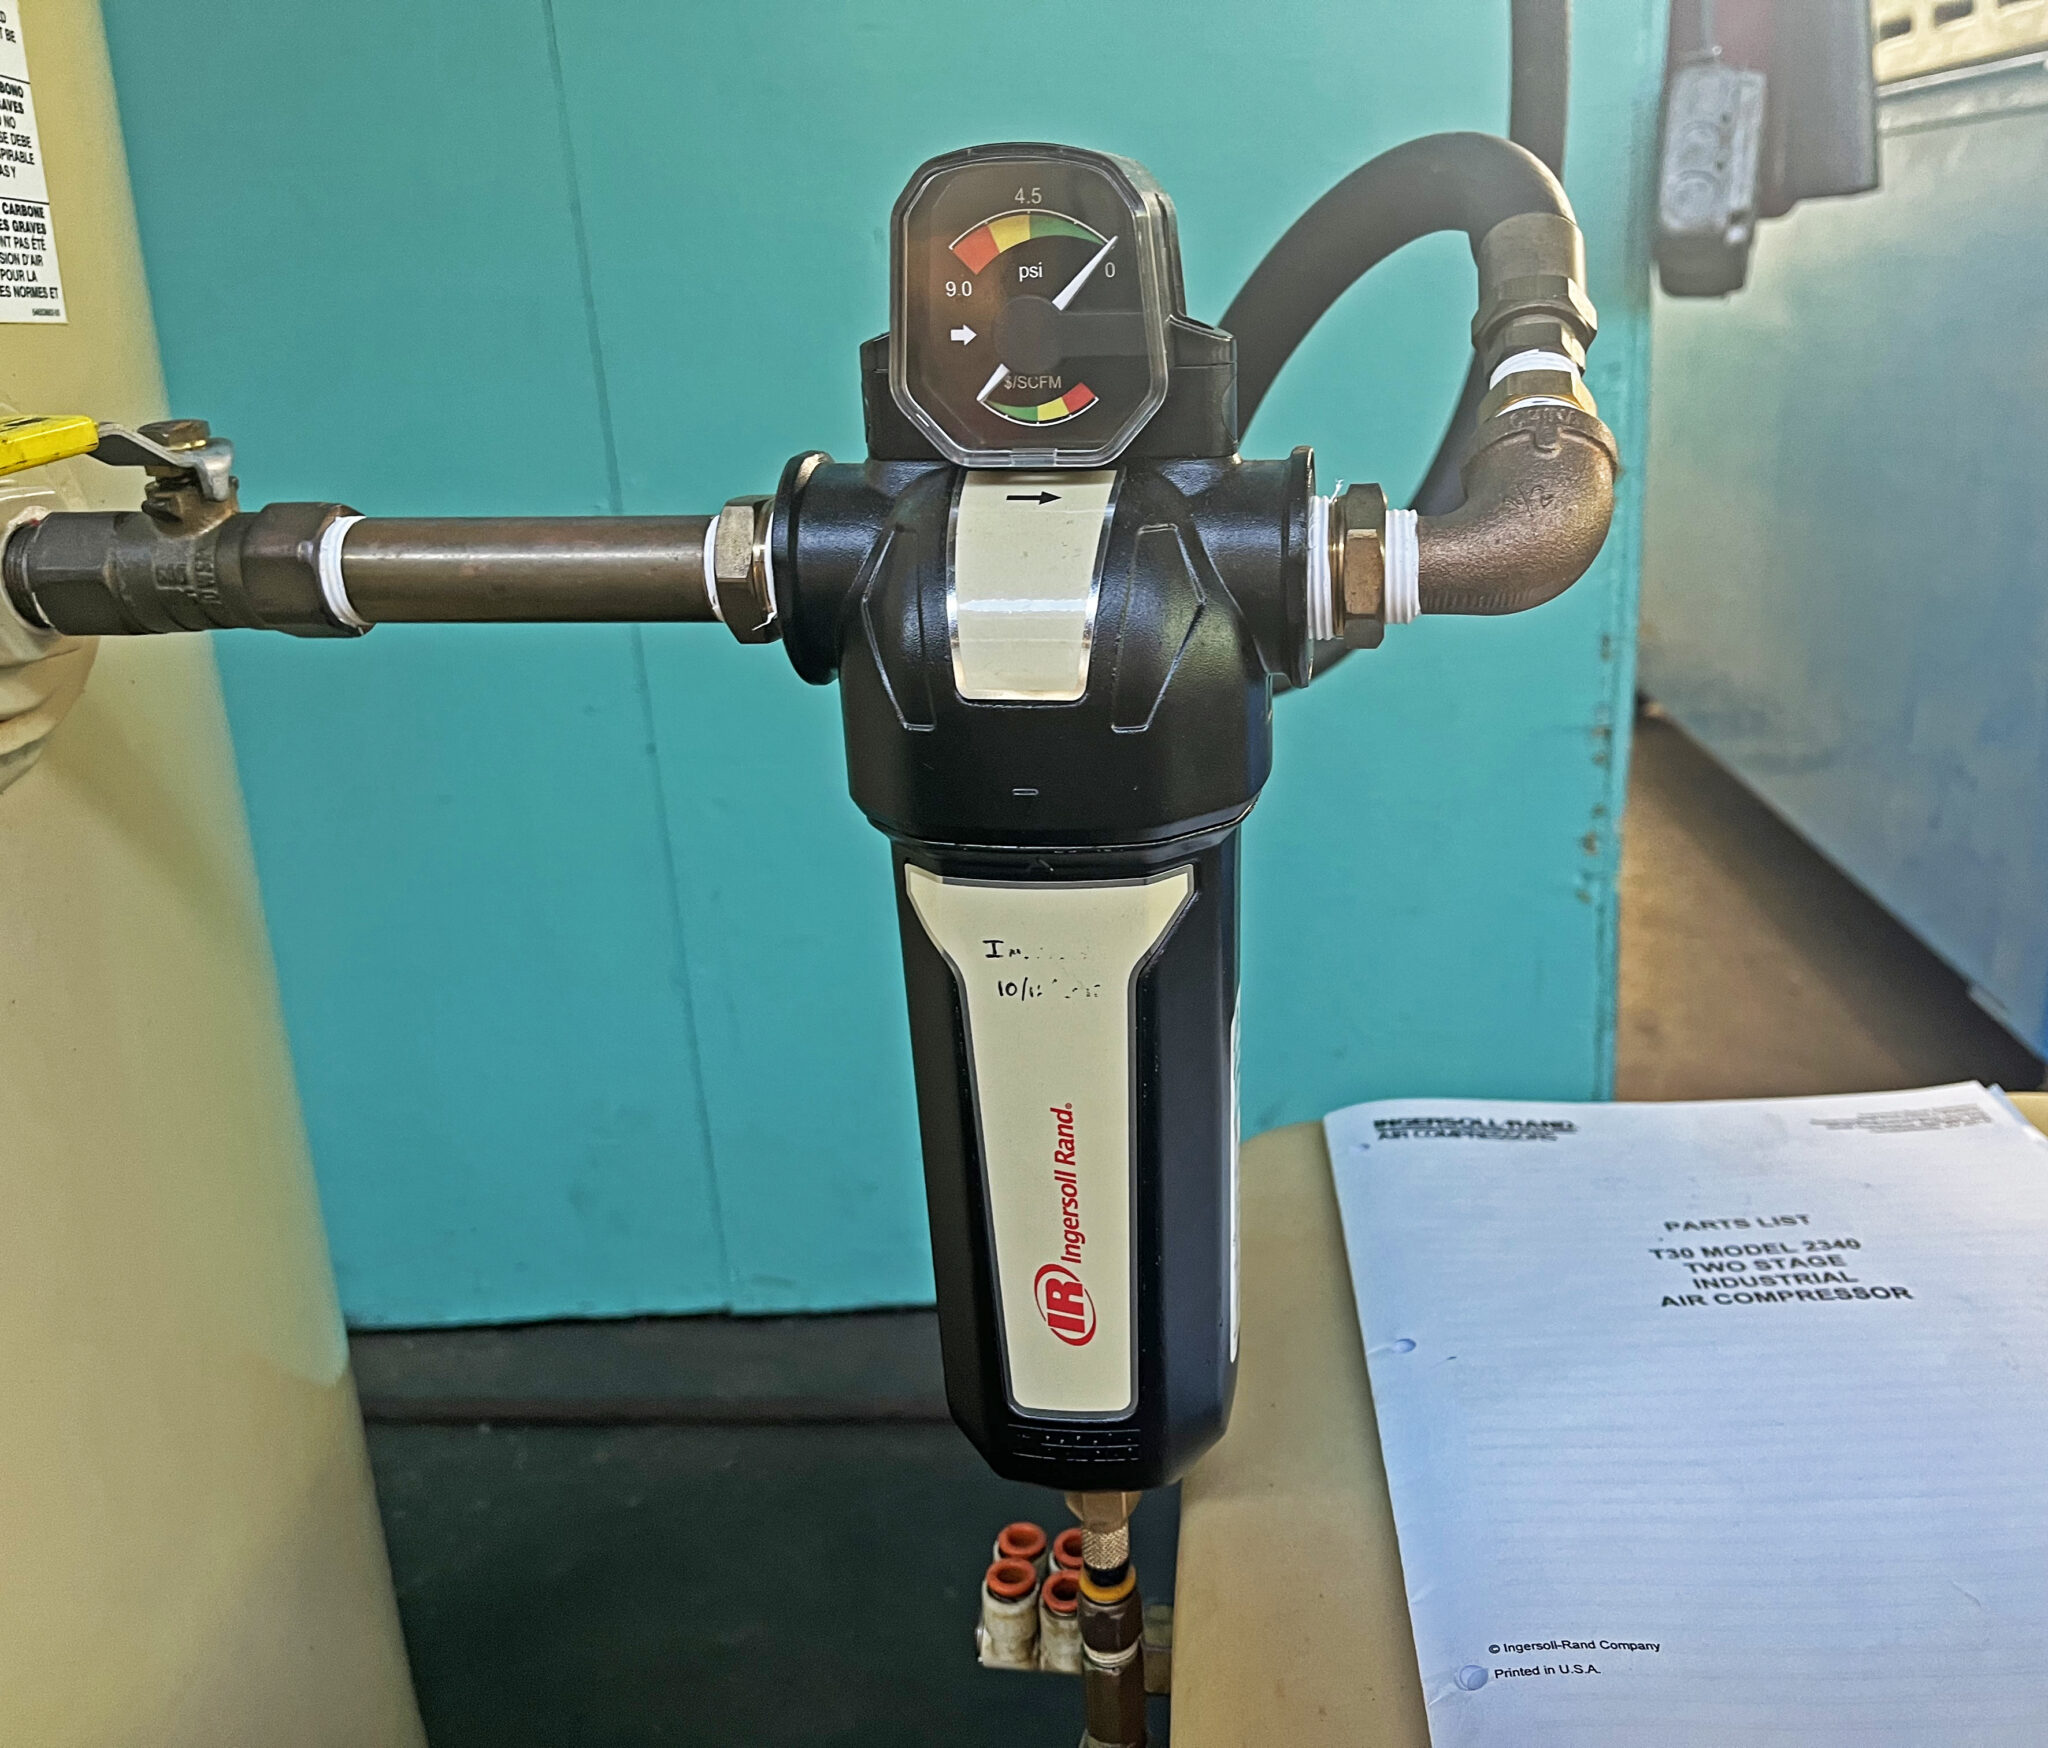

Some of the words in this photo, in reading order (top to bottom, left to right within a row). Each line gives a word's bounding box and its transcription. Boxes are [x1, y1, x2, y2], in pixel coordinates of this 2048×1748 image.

[1014, 187, 1043, 205] 4.5
[2, 202, 45, 219] CARBONE
[12, 220, 46, 235] GRAVES
[14, 236, 30, 250] PAS
[0, 269, 25, 282] POUR
[27, 270, 38, 282] LA
[1018, 262, 1043, 282] psi
[1104, 262, 1116, 278] 0
[13, 285, 48, 299] NORMES
[50, 286, 59, 299] ET
[945, 281, 972, 297] 9.0
[1004, 375, 1062, 390] $/SCFM
[1054, 1169, 1086, 1264] Ingersoll
[1663, 1217, 1751, 1232] PARTS
[1756, 1214, 1811, 1228] LIST
[1651, 1246, 1695, 1260] T30
[1701, 1241, 1799, 1259] MODEL
[1802, 1237, 1862, 1252] 2340
[1684, 1260, 1747, 1275] TWO
[1753, 1254, 1848, 1271] STAGE
[1692, 1271, 1860, 1290] INDUSTRIAL
[1661, 1294, 1708, 1307] AIR
[1713, 1286, 1914, 1306] COMPRESSOR
[1503, 1640, 1597, 1654] Ingersoll-Rand
[1599, 1640, 1661, 1653] Company
[1494, 1666, 1541, 1679] Printed
[1544, 1665, 1556, 1675] in
